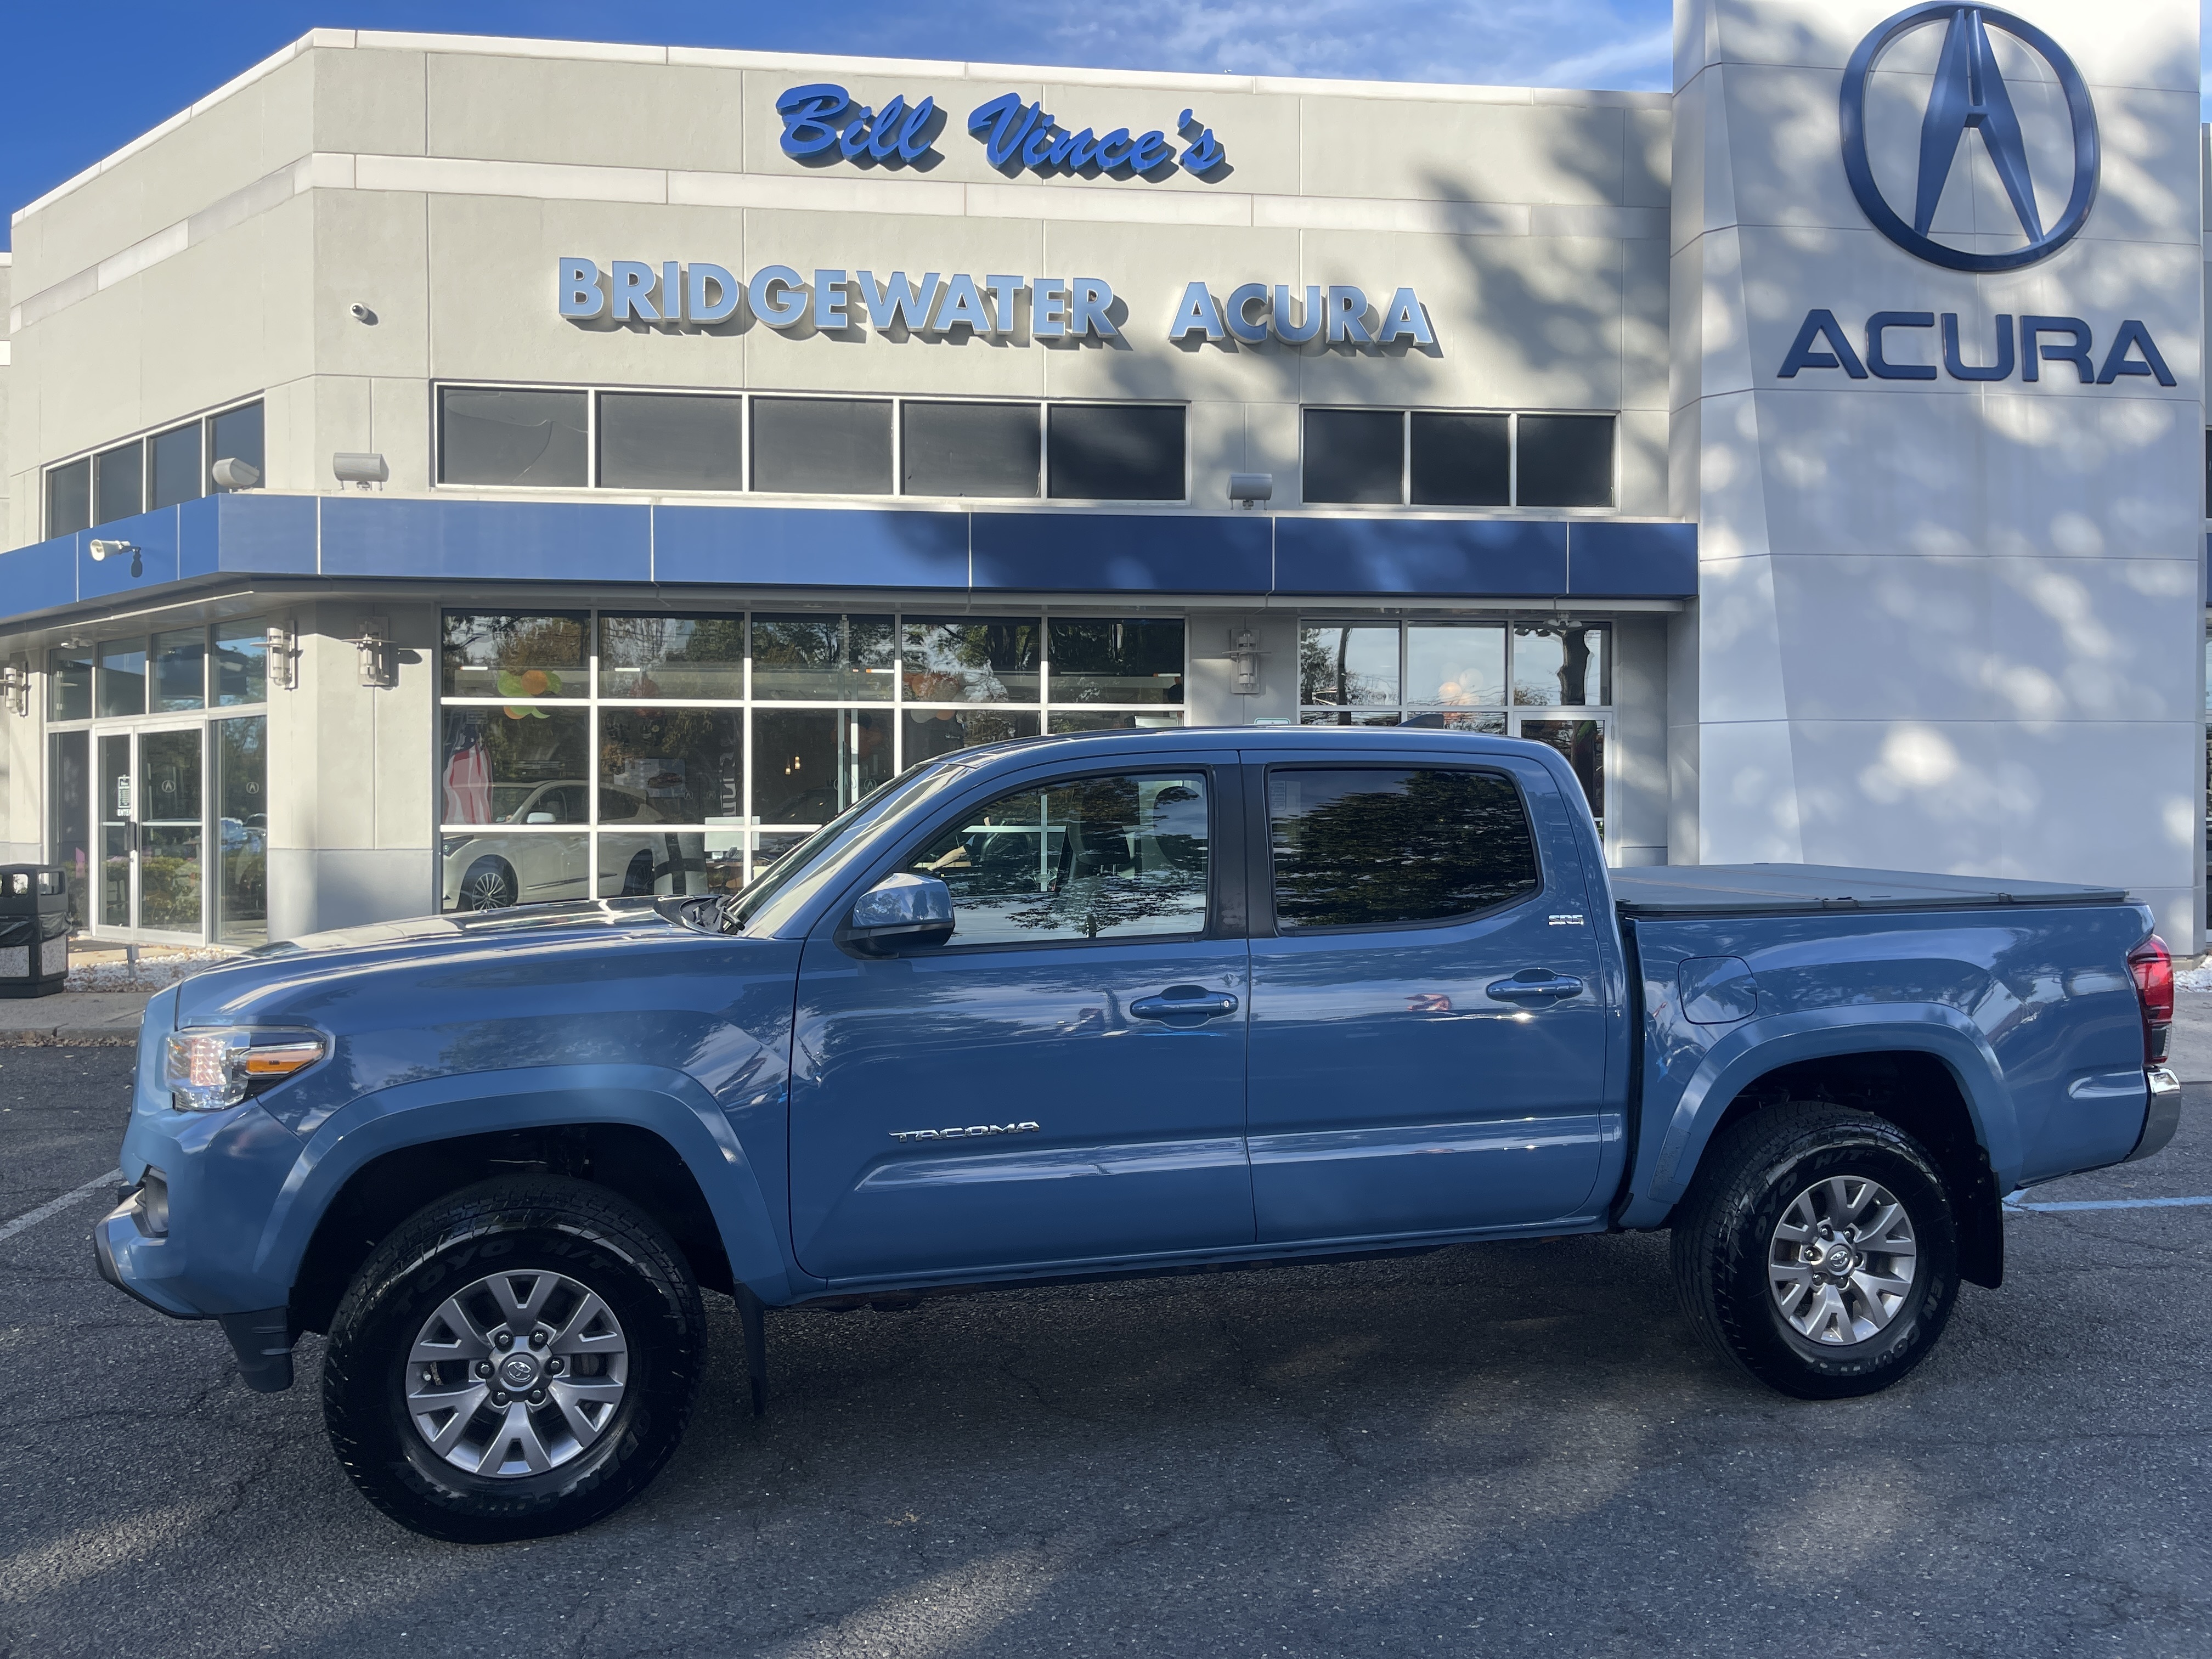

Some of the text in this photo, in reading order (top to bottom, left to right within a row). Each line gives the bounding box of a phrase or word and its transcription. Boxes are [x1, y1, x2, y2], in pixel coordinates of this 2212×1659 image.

[776, 83, 1224, 175] Bill Vince's
[558, 257, 1434, 346] BRIDGEWATER ACURA
[1776, 308, 2178, 387] ACURA
[1548, 914, 1584, 926] SR5
[888, 1121, 1040, 1143] TACOMA
[391, 1238, 515, 1317] TOYO
